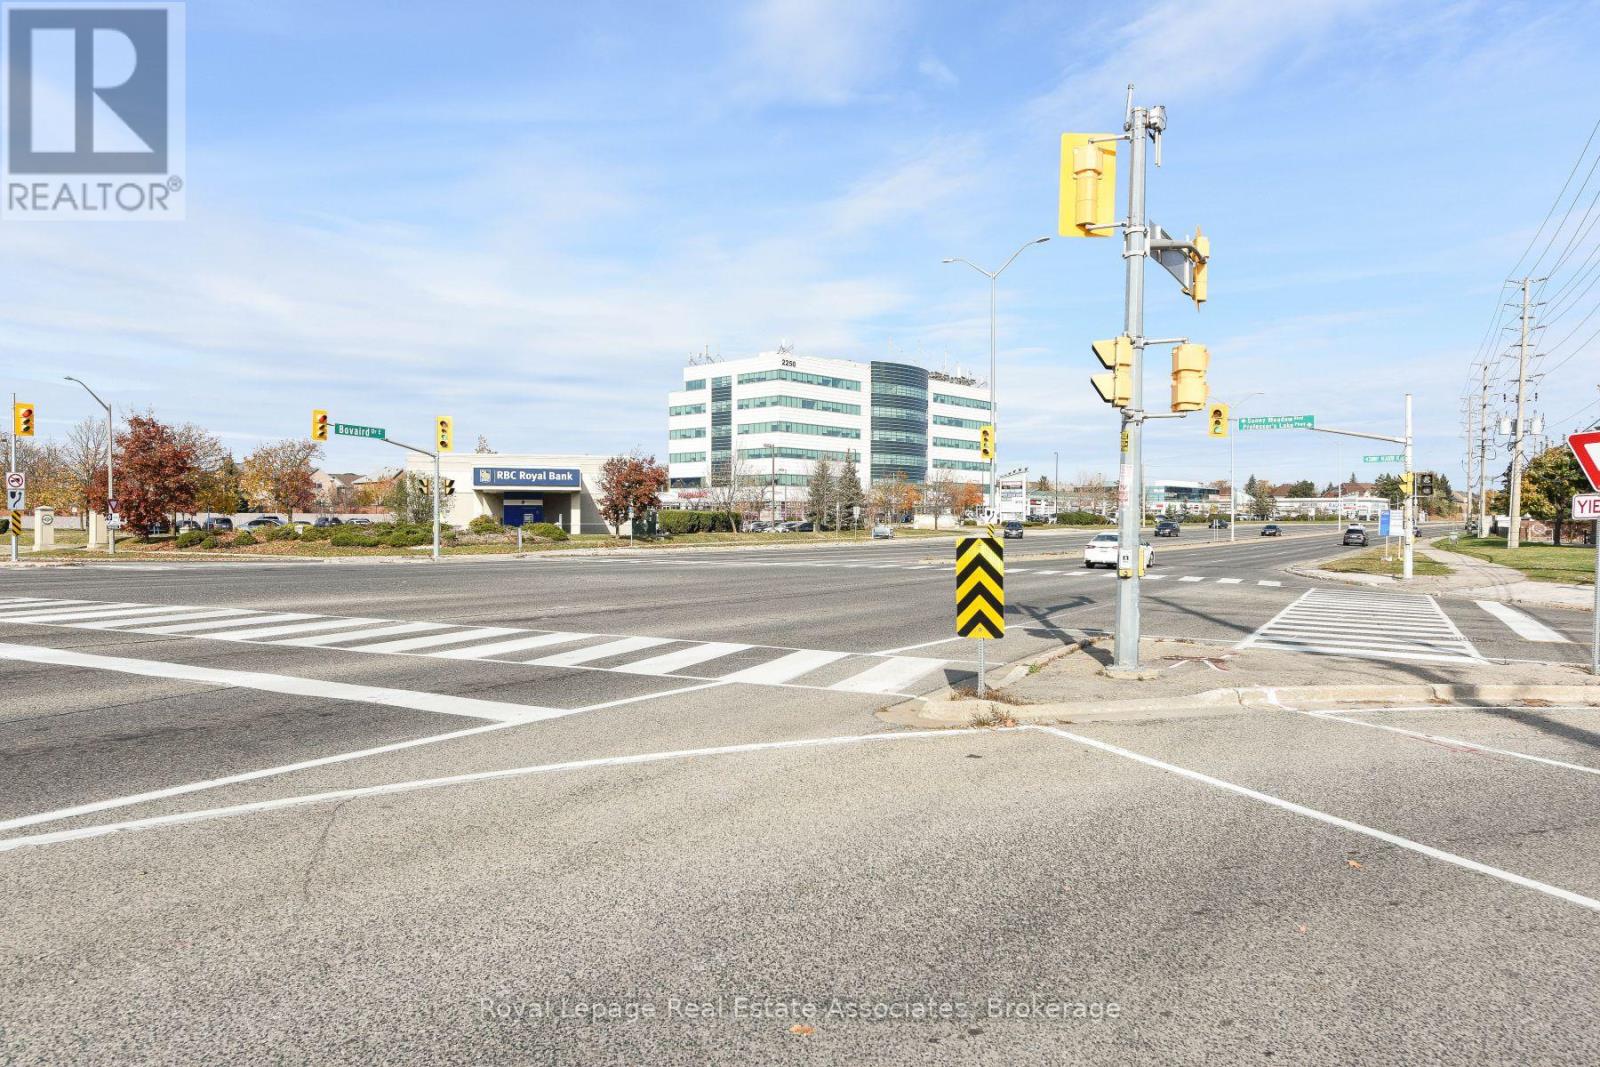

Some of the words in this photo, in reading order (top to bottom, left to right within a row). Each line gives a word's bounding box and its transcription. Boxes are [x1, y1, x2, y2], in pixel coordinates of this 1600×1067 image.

[781, 359, 796, 368] 2250
[338, 424, 370, 437] Bovaird
[496, 470, 517, 480] RBC
[519, 471, 546, 482] Royal
[548, 472, 573, 481] Bank
